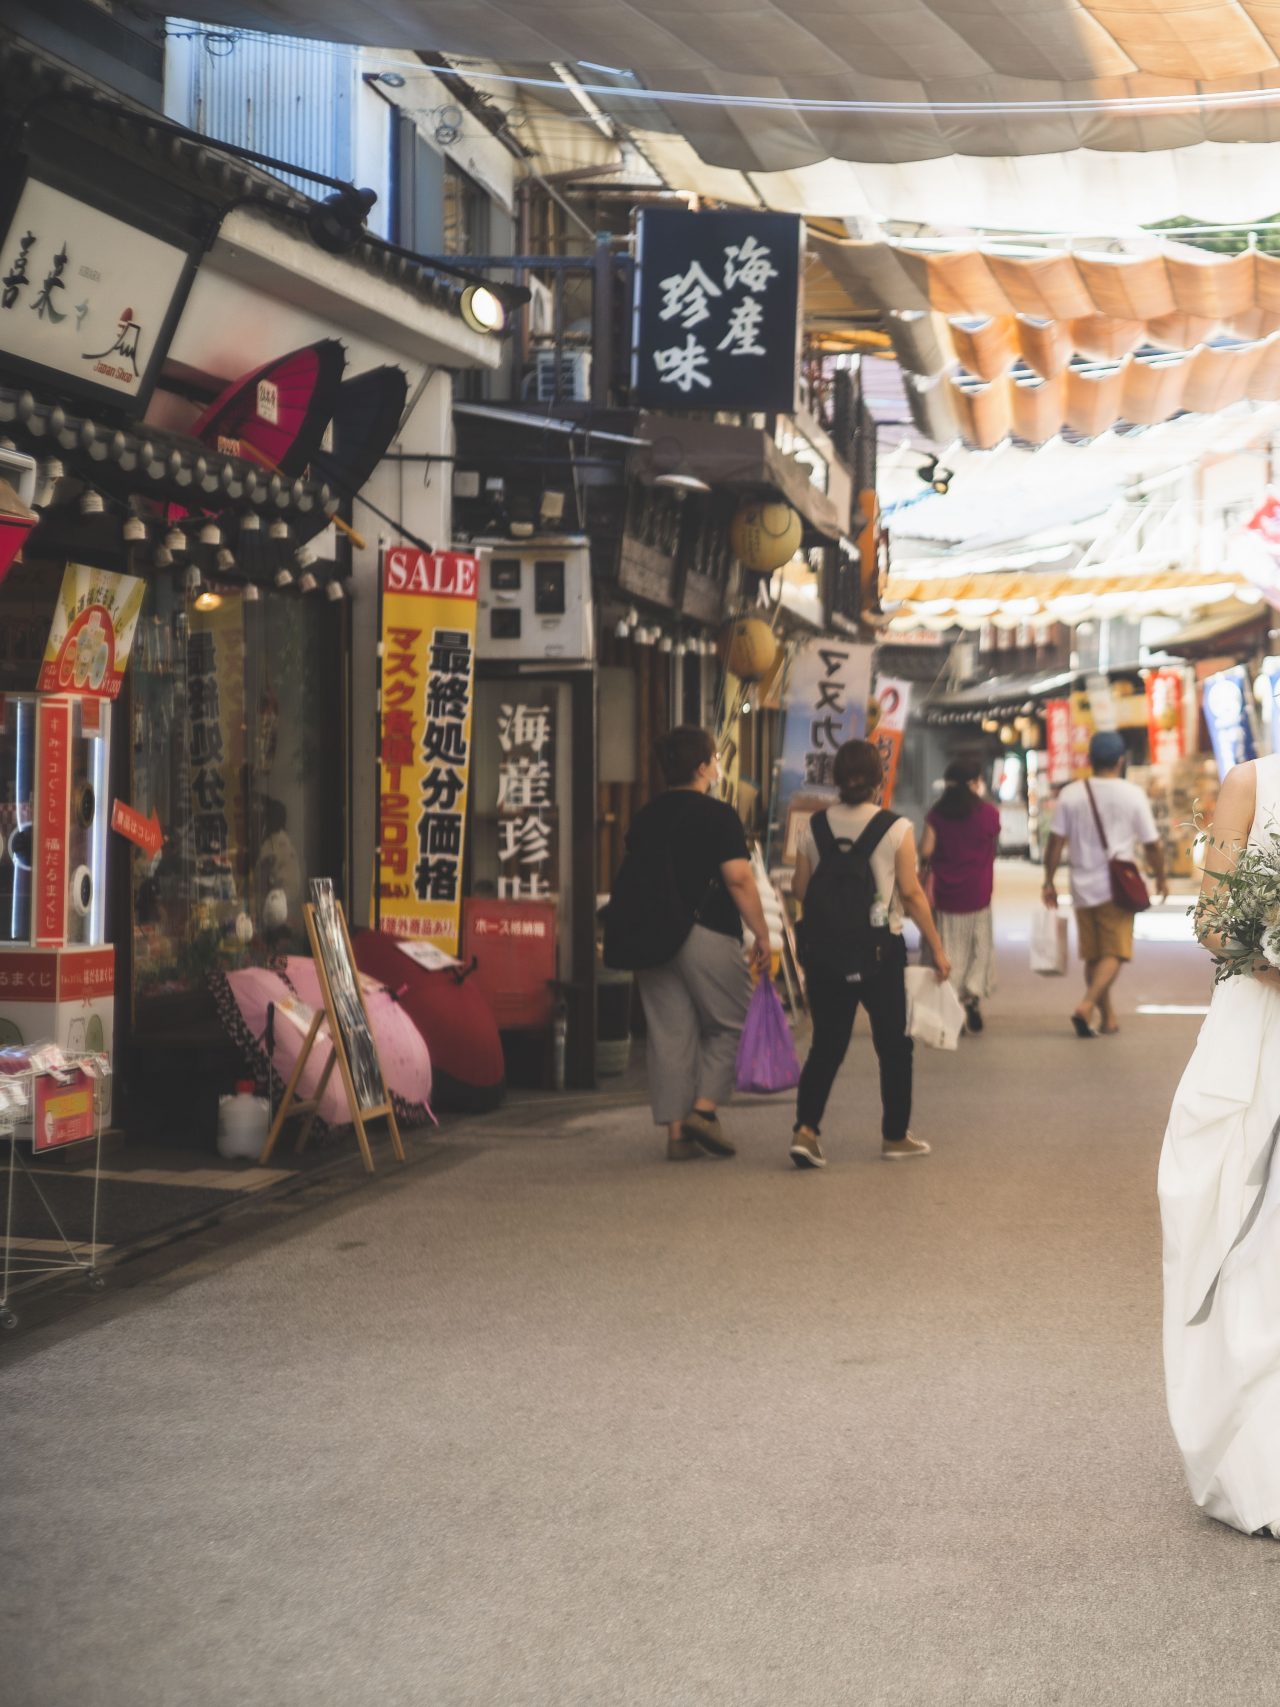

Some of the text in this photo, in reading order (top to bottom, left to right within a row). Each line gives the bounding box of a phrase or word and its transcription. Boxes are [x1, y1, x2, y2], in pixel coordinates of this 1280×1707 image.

[653, 260, 722, 392] 珍味
[716, 235, 779, 356] 海産
[93, 360, 133, 383] Japan Shop
[387, 551, 477, 595] SALE
[414, 629, 472, 903] 最終処分価格
[45, 838, 60, 929] 福だるまくじ
[475, 919, 546, 937] ホース格納箱
